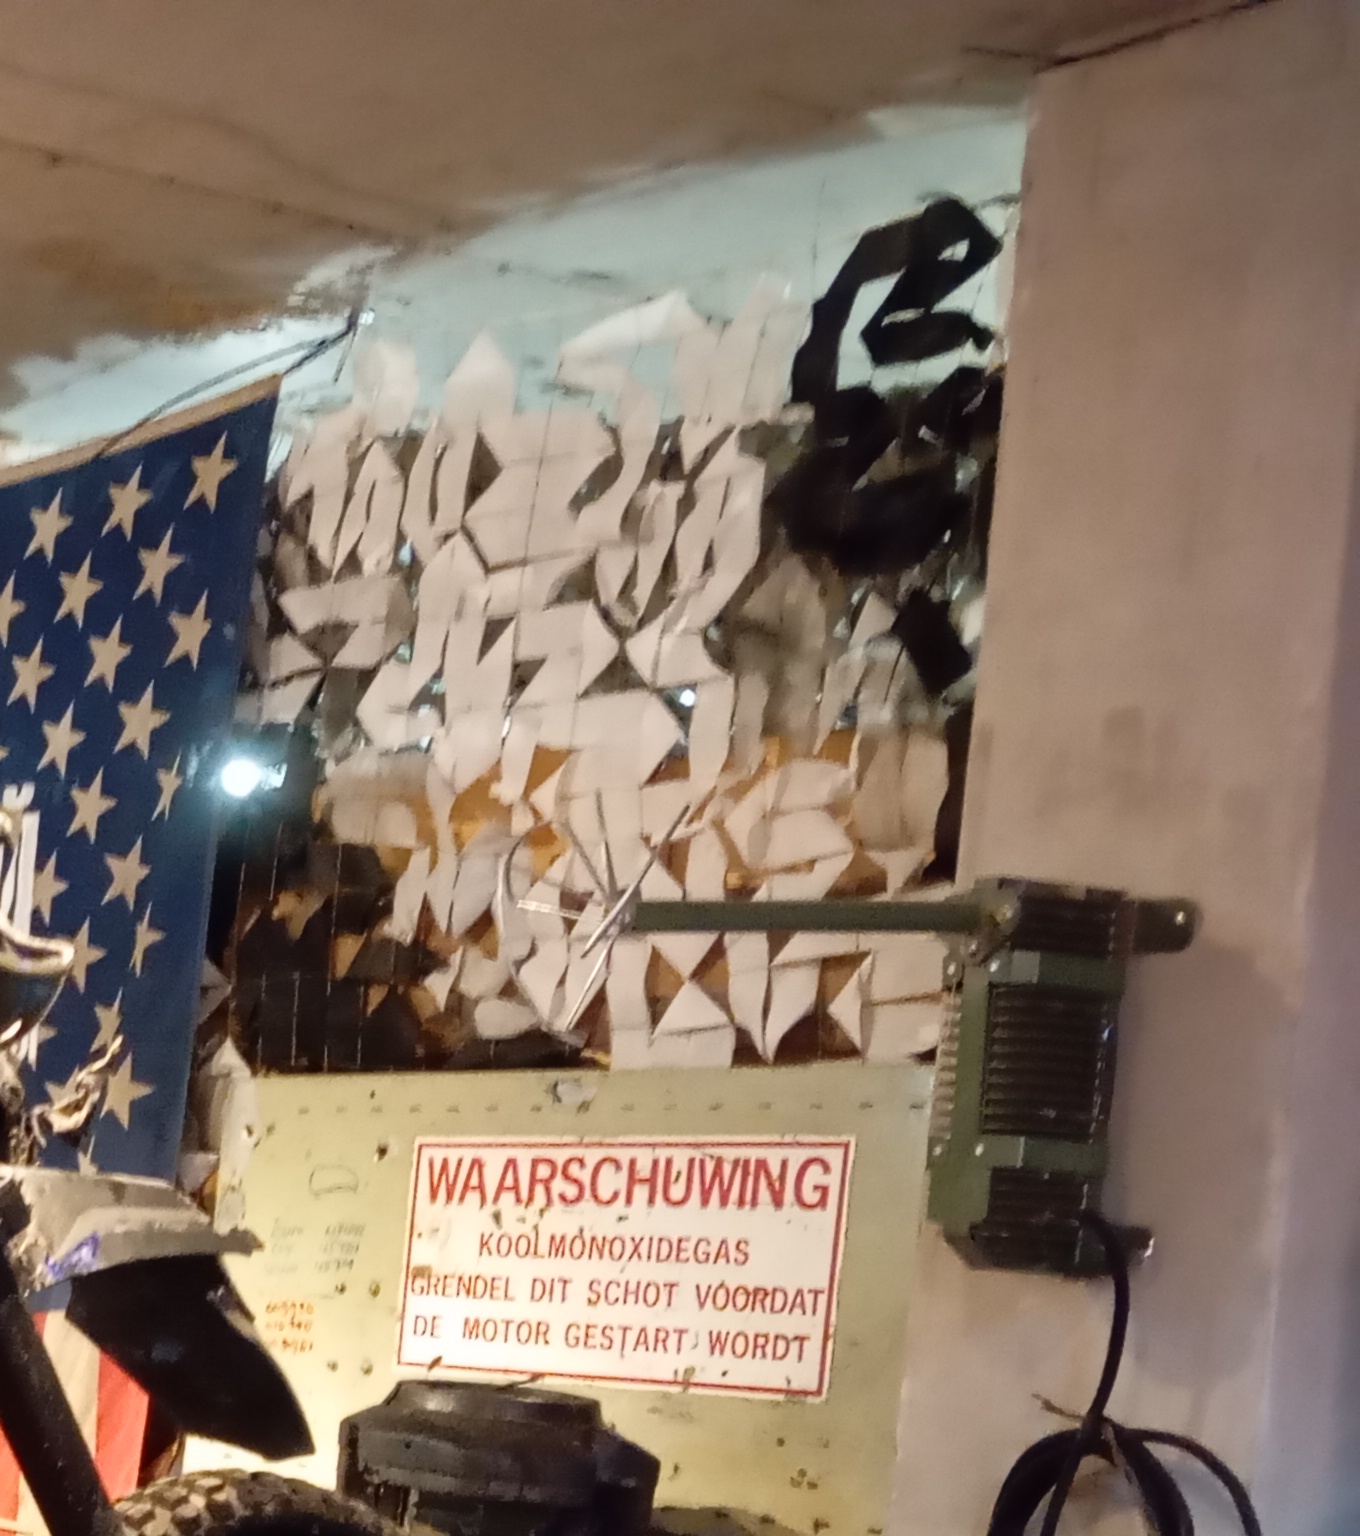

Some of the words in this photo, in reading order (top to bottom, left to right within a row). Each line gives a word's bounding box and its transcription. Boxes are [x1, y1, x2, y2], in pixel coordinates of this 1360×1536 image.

[426, 1155, 833, 1212] WAARSCHUWING
[478, 1231, 751, 1267] KOOLMONOXIDEGAS
[410, 1274, 516, 1302] GRENDEL
[530, 1277, 573, 1304] DIT
[586, 1278, 680, 1309] SCHOT
[695, 1282, 826, 1317] VOORDAT
[412, 1315, 442, 1339] DE
[462, 1317, 550, 1345] MOTOR
[563, 1323, 690, 1355] GESTART
[708, 1330, 811, 1363] WORDT
